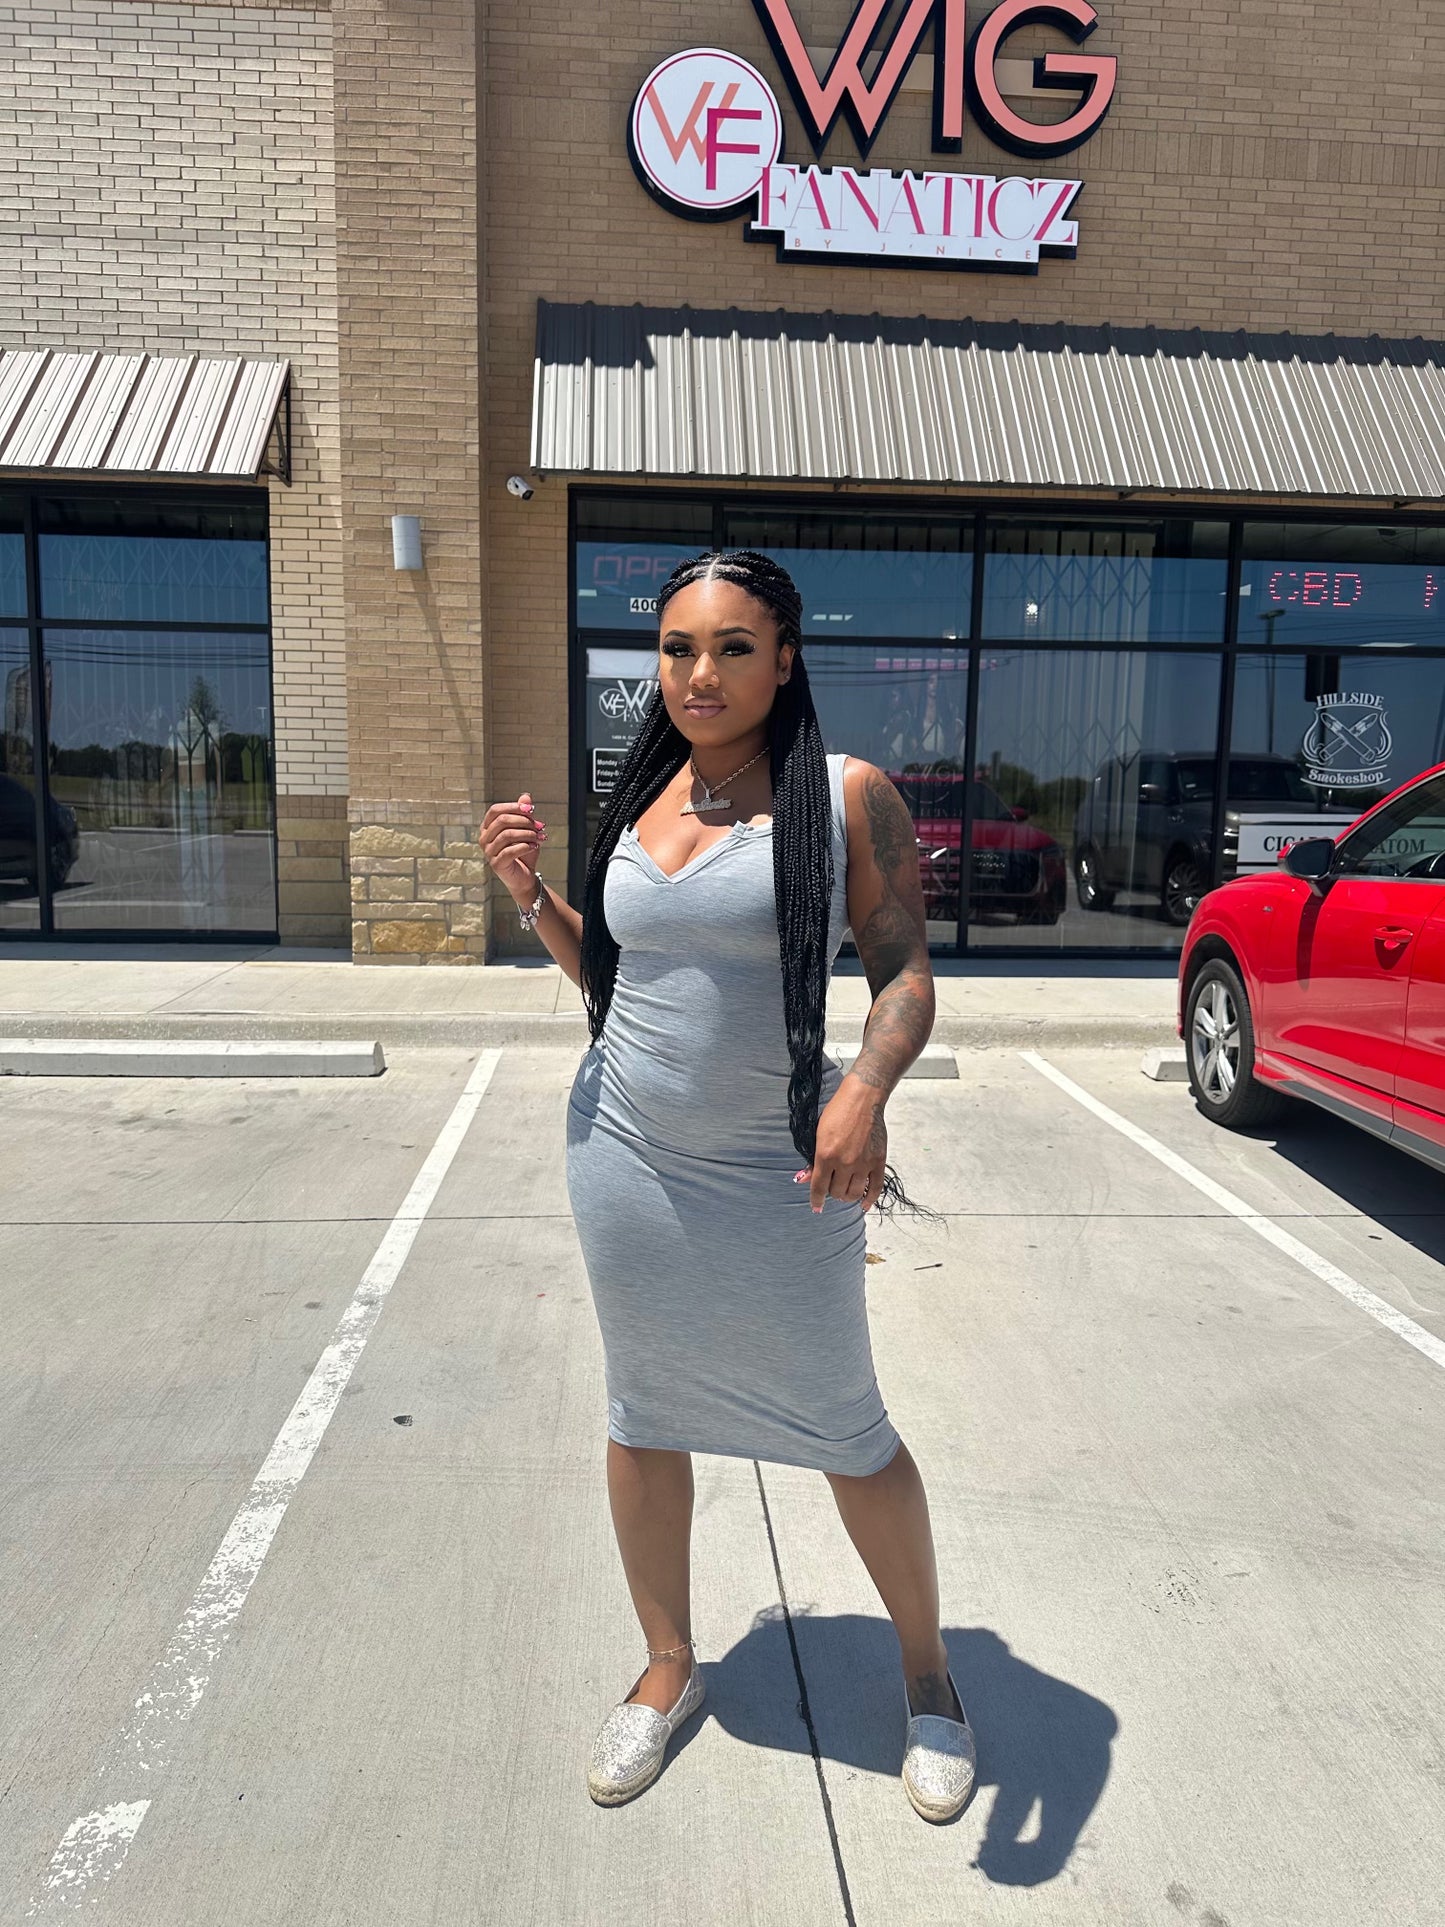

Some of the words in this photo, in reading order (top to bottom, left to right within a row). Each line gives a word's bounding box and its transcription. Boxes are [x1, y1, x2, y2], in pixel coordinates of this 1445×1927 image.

[752, 0, 1117, 146] WIG
[754, 164, 1079, 243] FANATICZ
[794, 237, 832, 249] BY
[1269, 572, 1362, 606] CBD
[1316, 692, 1384, 707] HILLSIDE
[597, 759, 618, 767] Monday
[1308, 768, 1384, 785] Smokeshop
